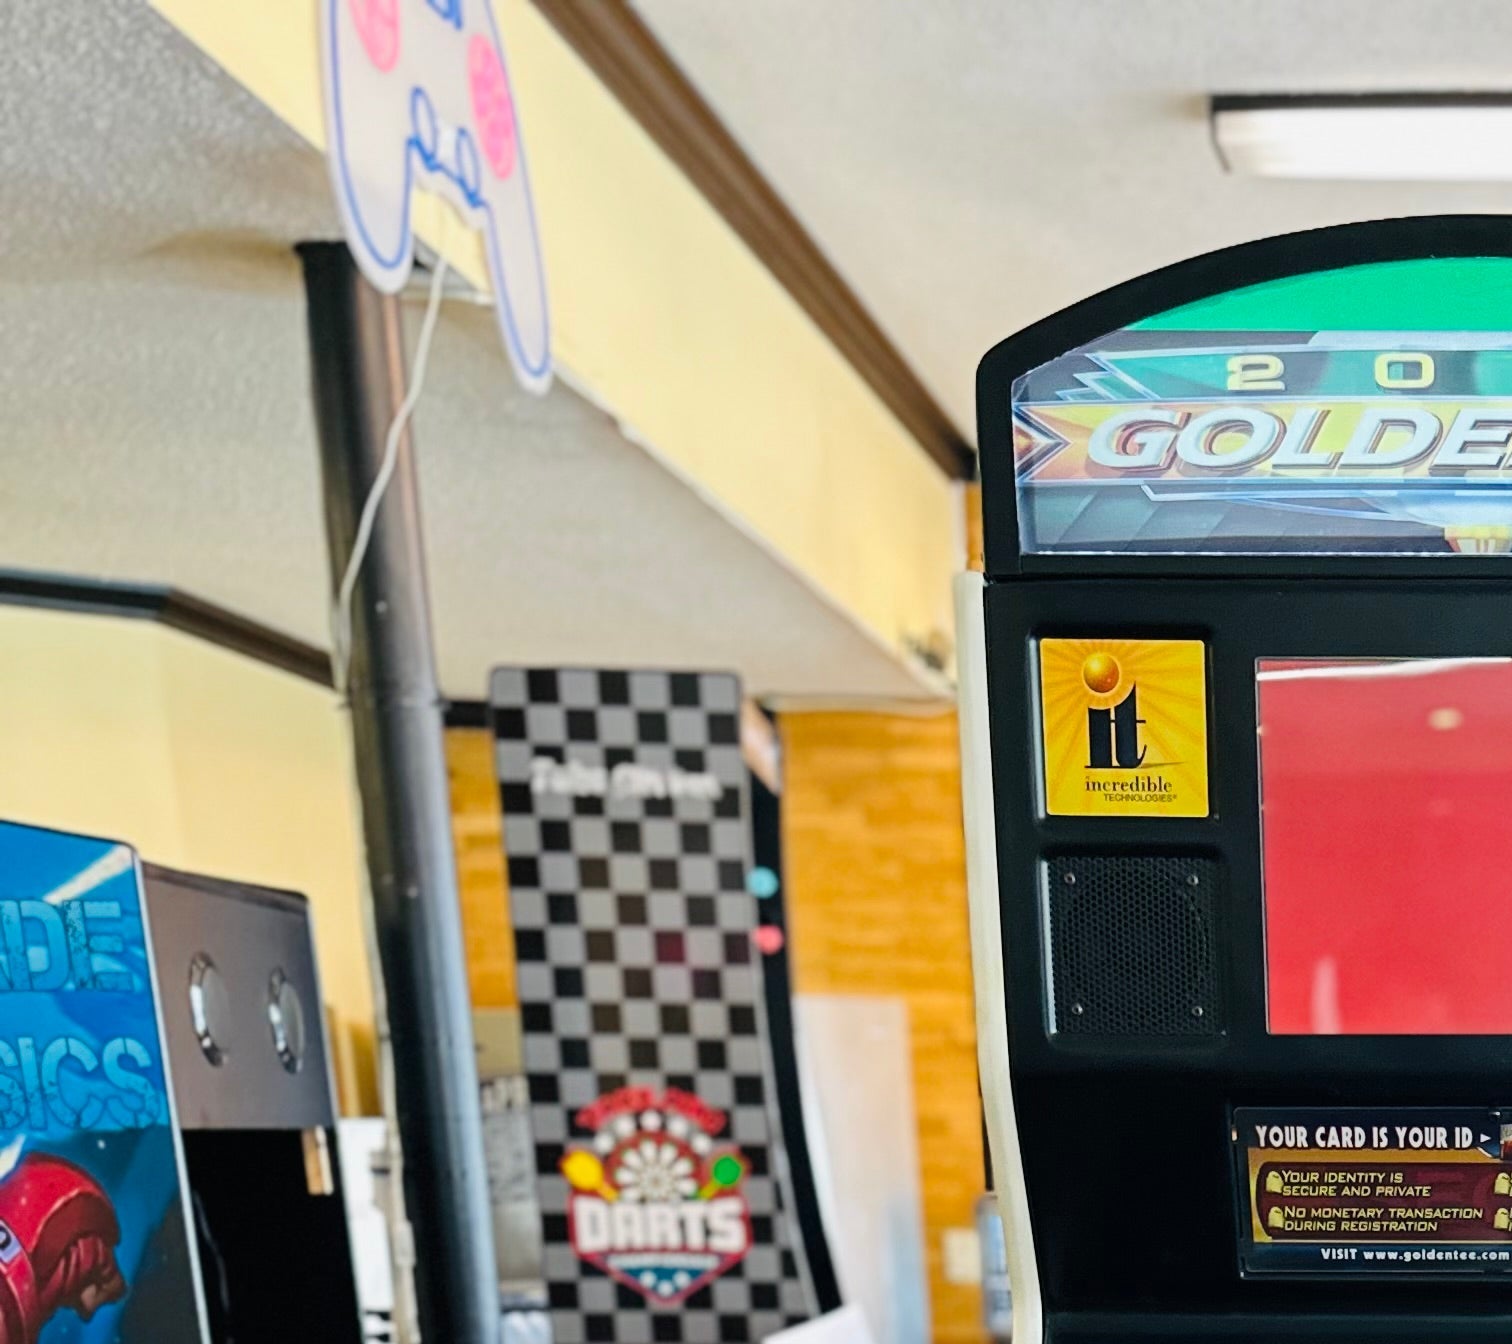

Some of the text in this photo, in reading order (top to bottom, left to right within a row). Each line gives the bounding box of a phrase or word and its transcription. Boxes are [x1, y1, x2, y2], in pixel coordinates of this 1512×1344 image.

[1085, 776, 1173, 793] incredible
[1255, 1125, 1309, 1149] YOUR
[1315, 1125, 1366, 1149] CARD
[1372, 1126, 1389, 1149] IS
[1395, 1126, 1448, 1149] YOUR
[1454, 1126, 1473, 1149] ID
[1324, 1172, 1386, 1184] IDENTITY
[1390, 1172, 1403, 1183] IS
[1282, 1186, 1432, 1198] SECURE AND PRIVATE
[1311, 1207, 1384, 1219] MONETARY
[1389, 1207, 1483, 1219] TRANSACTION
[572, 1194, 746, 1254] DARTS
[1284, 1220, 1438, 1232] DURING REGISTRATION
[1320, 1248, 1358, 1261] VISIT
[1363, 1248, 1510, 1262] www.goldentee.com
